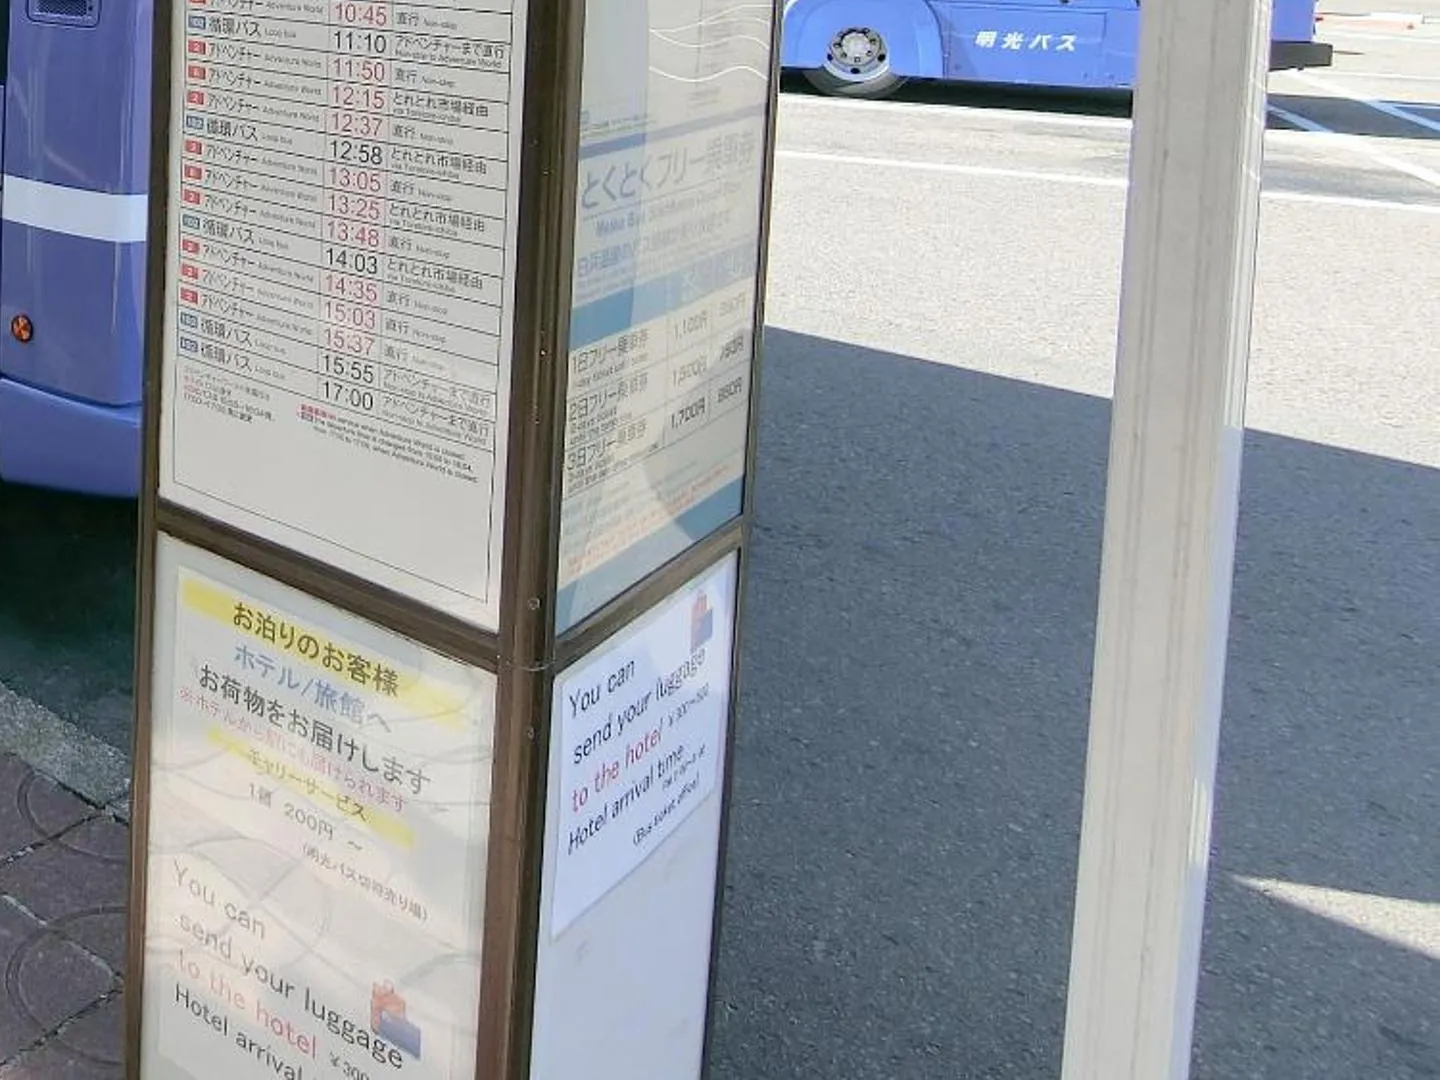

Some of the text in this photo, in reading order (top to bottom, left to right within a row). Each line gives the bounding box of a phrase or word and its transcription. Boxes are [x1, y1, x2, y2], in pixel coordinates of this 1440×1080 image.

[335, 2, 388, 27] 10:45
[334, 30, 387, 54] 11:10
[974, 29, 1078, 53] 明光バス
[333, 58, 386, 82] 11:50
[332, 85, 385, 110] 12:15
[331, 111, 383, 137] 12:37
[330, 139, 383, 165] 12:58
[329, 167, 381, 193] 13:05
[328, 194, 380, 220] 13:25
[327, 220, 380, 248] 13:48
[326, 247, 378, 275] 14:03
[325, 274, 378, 303] 14:35
[324, 301, 376, 331] 15:03
[323, 327, 375, 356] 15:37
[323, 354, 374, 385] 15:55
[323, 381, 374, 411] 17:00
[231, 600, 401, 698] お泊りのお客様
[234, 643, 393, 734] ホテル/旅館へ
[567, 659, 636, 719] You can
[573, 714, 613, 766] send
[614, 690, 652, 738] your
[655, 646, 707, 703] luggage
[199, 663, 432, 796] お荷物をお届けします
[571, 786, 589, 815] to
[593, 756, 620, 795] the
[624, 716, 664, 773] hotel
[567, 806, 609, 857] Hotel
[610, 770, 655, 820] arrival
[657, 744, 685, 781] time
[283, 802, 334, 841] 200円
[172, 856, 267, 941] You can
[178, 914, 405, 1070] send your luggage
[178, 950, 318, 1061] to the hotel
[175, 982, 304, 1080] Hotel arrival
